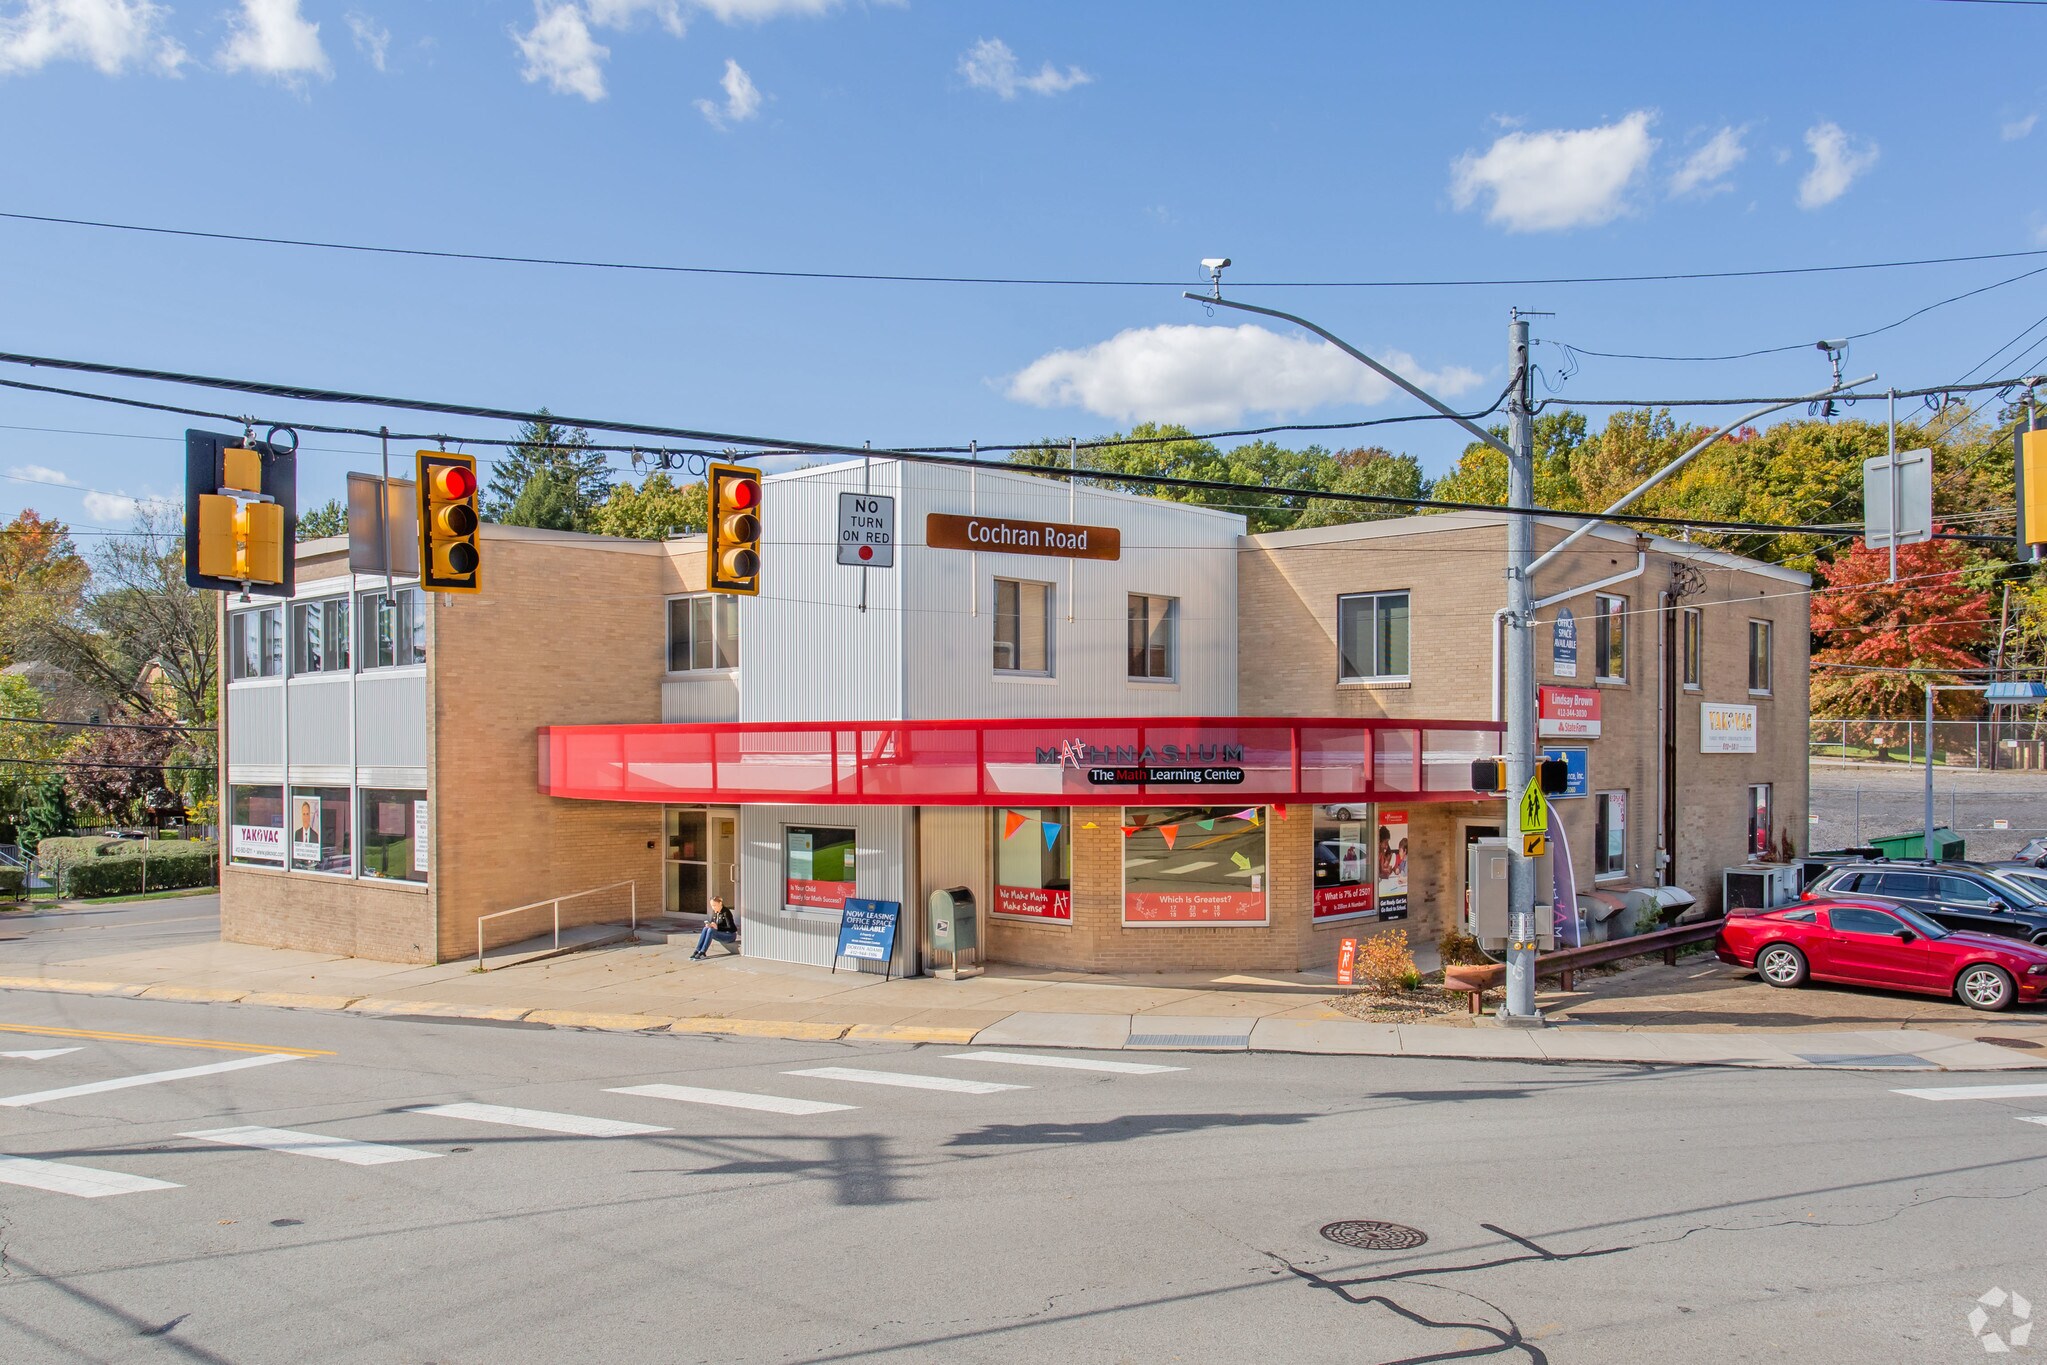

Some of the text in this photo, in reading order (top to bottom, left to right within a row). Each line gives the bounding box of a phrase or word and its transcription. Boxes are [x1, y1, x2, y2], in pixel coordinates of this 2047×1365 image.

[855, 499, 879, 514] NO
[851, 515, 883, 529] TURN
[842, 530, 890, 544] ON RED
[967, 521, 1088, 550] Cochran Road
[1557, 618, 1573, 628] OFFICE
[1558, 629, 1572, 638] SPACE
[1554, 639, 1576, 649] AVAILABLE
[1551, 693, 1593, 708] Lindsay Brown
[1091, 768, 1241, 783] The Math Learning Center
[790, 894, 803, 902] Ready
[823, 896, 842, 904] Success?
[1000, 889, 1048, 902] We Make Math
[1159, 895, 1183, 903] Which
[1194, 895, 1232, 904] Greatest?
[1325, 892, 1338, 901] What
[1344, 891, 1352, 899] 7%
[1003, 901, 1020, 911] Make
[846, 910, 895, 921] NOW LEASING
[846, 917, 893, 928] OFFICE SPACE
[851, 924, 886, 934] AVAILABLE
